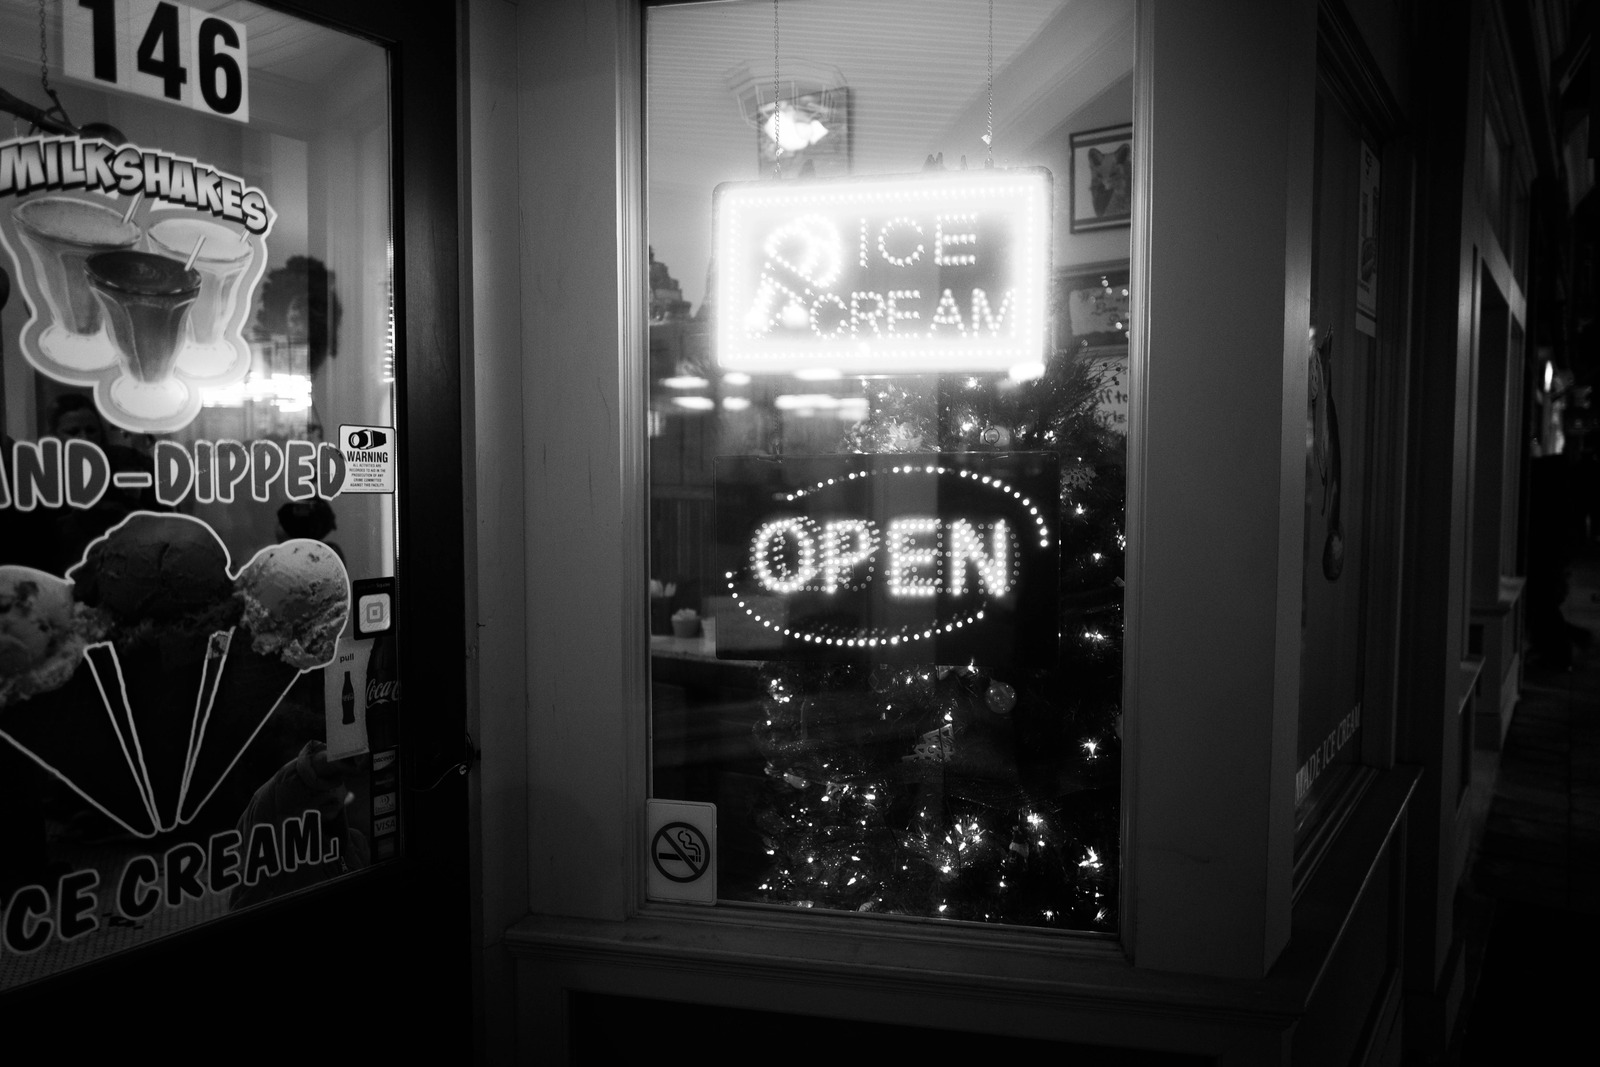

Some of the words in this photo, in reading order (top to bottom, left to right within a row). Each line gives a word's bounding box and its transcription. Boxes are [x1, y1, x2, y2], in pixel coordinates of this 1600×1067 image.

[79, 0, 242, 115] 146
[0, 140, 268, 234] MILKSHAKES
[860, 213, 977, 268] ICE
[811, 288, 1016, 340] CREAM
[0, 437, 347, 512] ND-DIPPED
[347, 451, 388, 463] WARNING
[751, 516, 1016, 597] OPEN
[340, 653, 354, 663] pull
[376, 820, 396, 831] VISA
[0, 868, 100, 953] CE
[117, 810, 322, 918] CREAM
